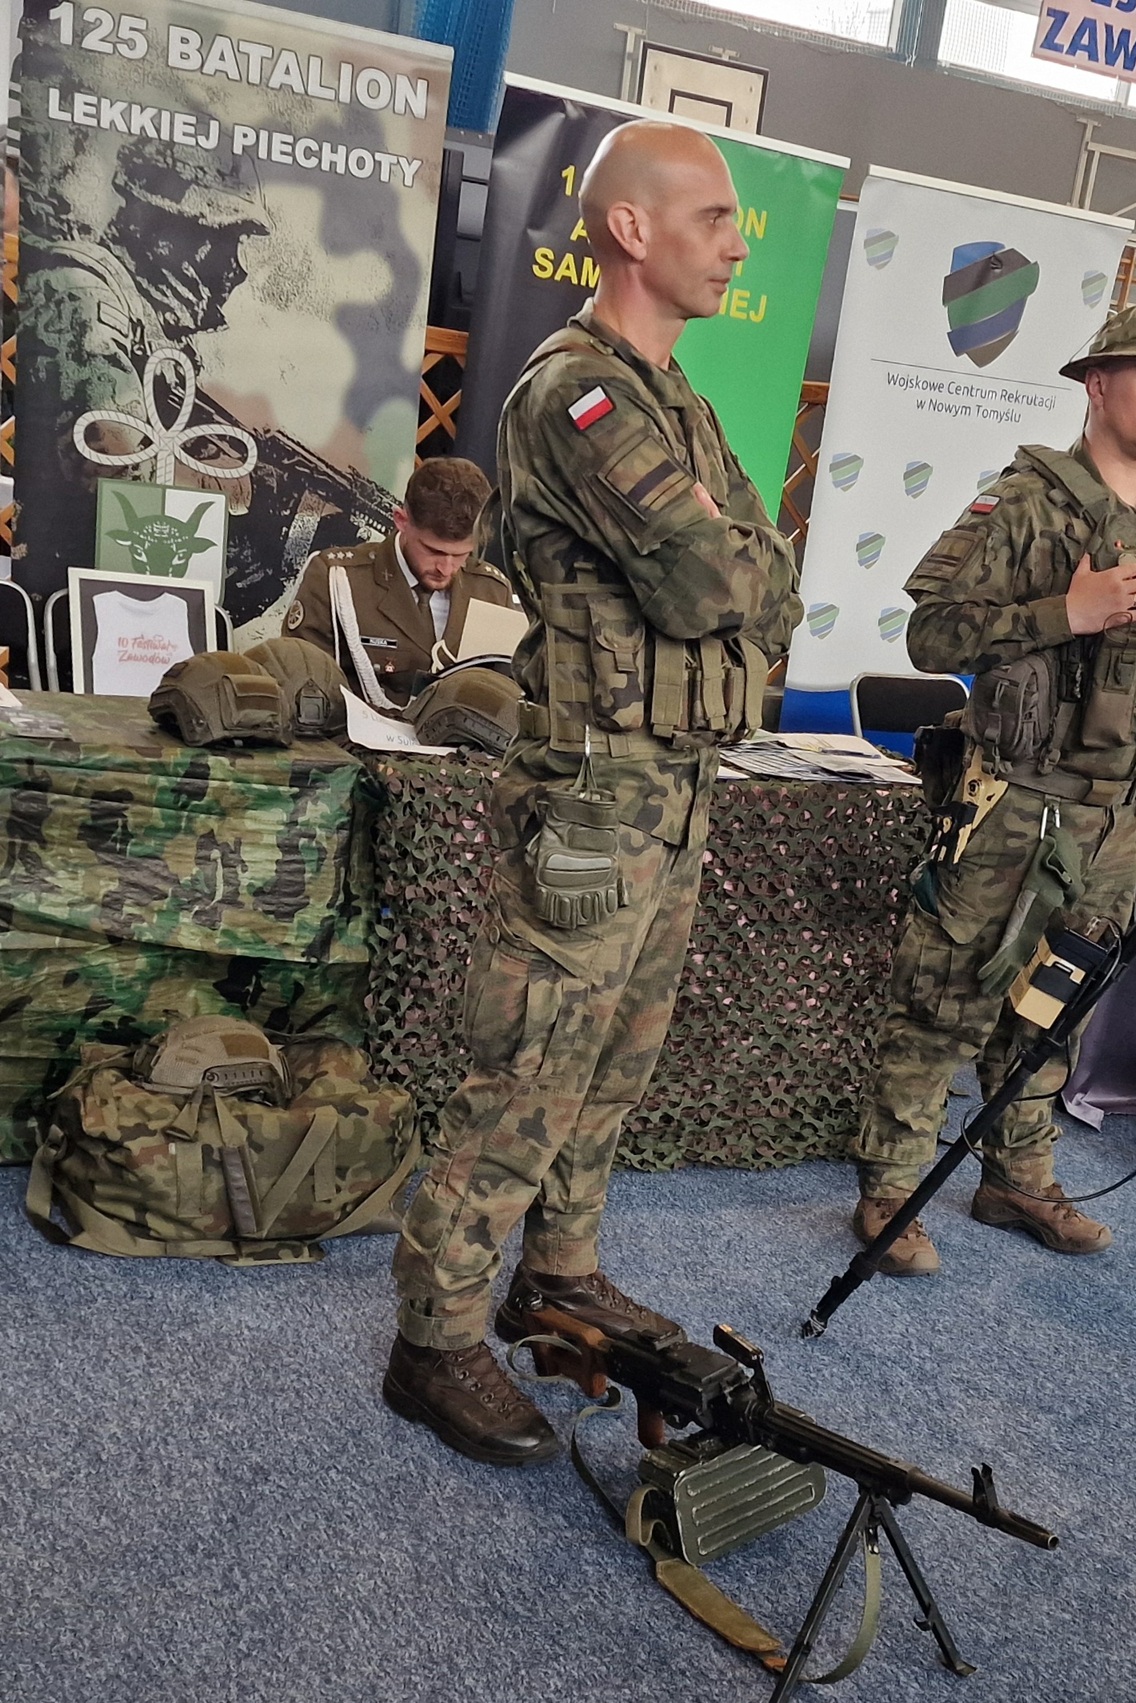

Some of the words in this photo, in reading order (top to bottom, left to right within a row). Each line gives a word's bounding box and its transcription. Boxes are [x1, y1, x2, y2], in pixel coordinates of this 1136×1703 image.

[48, 1, 149, 61] 125
[166, 25, 430, 121] BATALION
[48, 87, 220, 151] LEKKIEJ
[232, 125, 423, 188] PIECHOTY
[887, 371, 944, 393] Wojskowe
[947, 381, 998, 401] Centrum
[1000, 388, 1056, 411] Rekrutacji
[915, 399, 926, 411] w
[928, 398, 972, 418] Nowym
[976, 404, 1021, 425] Tomyślu
